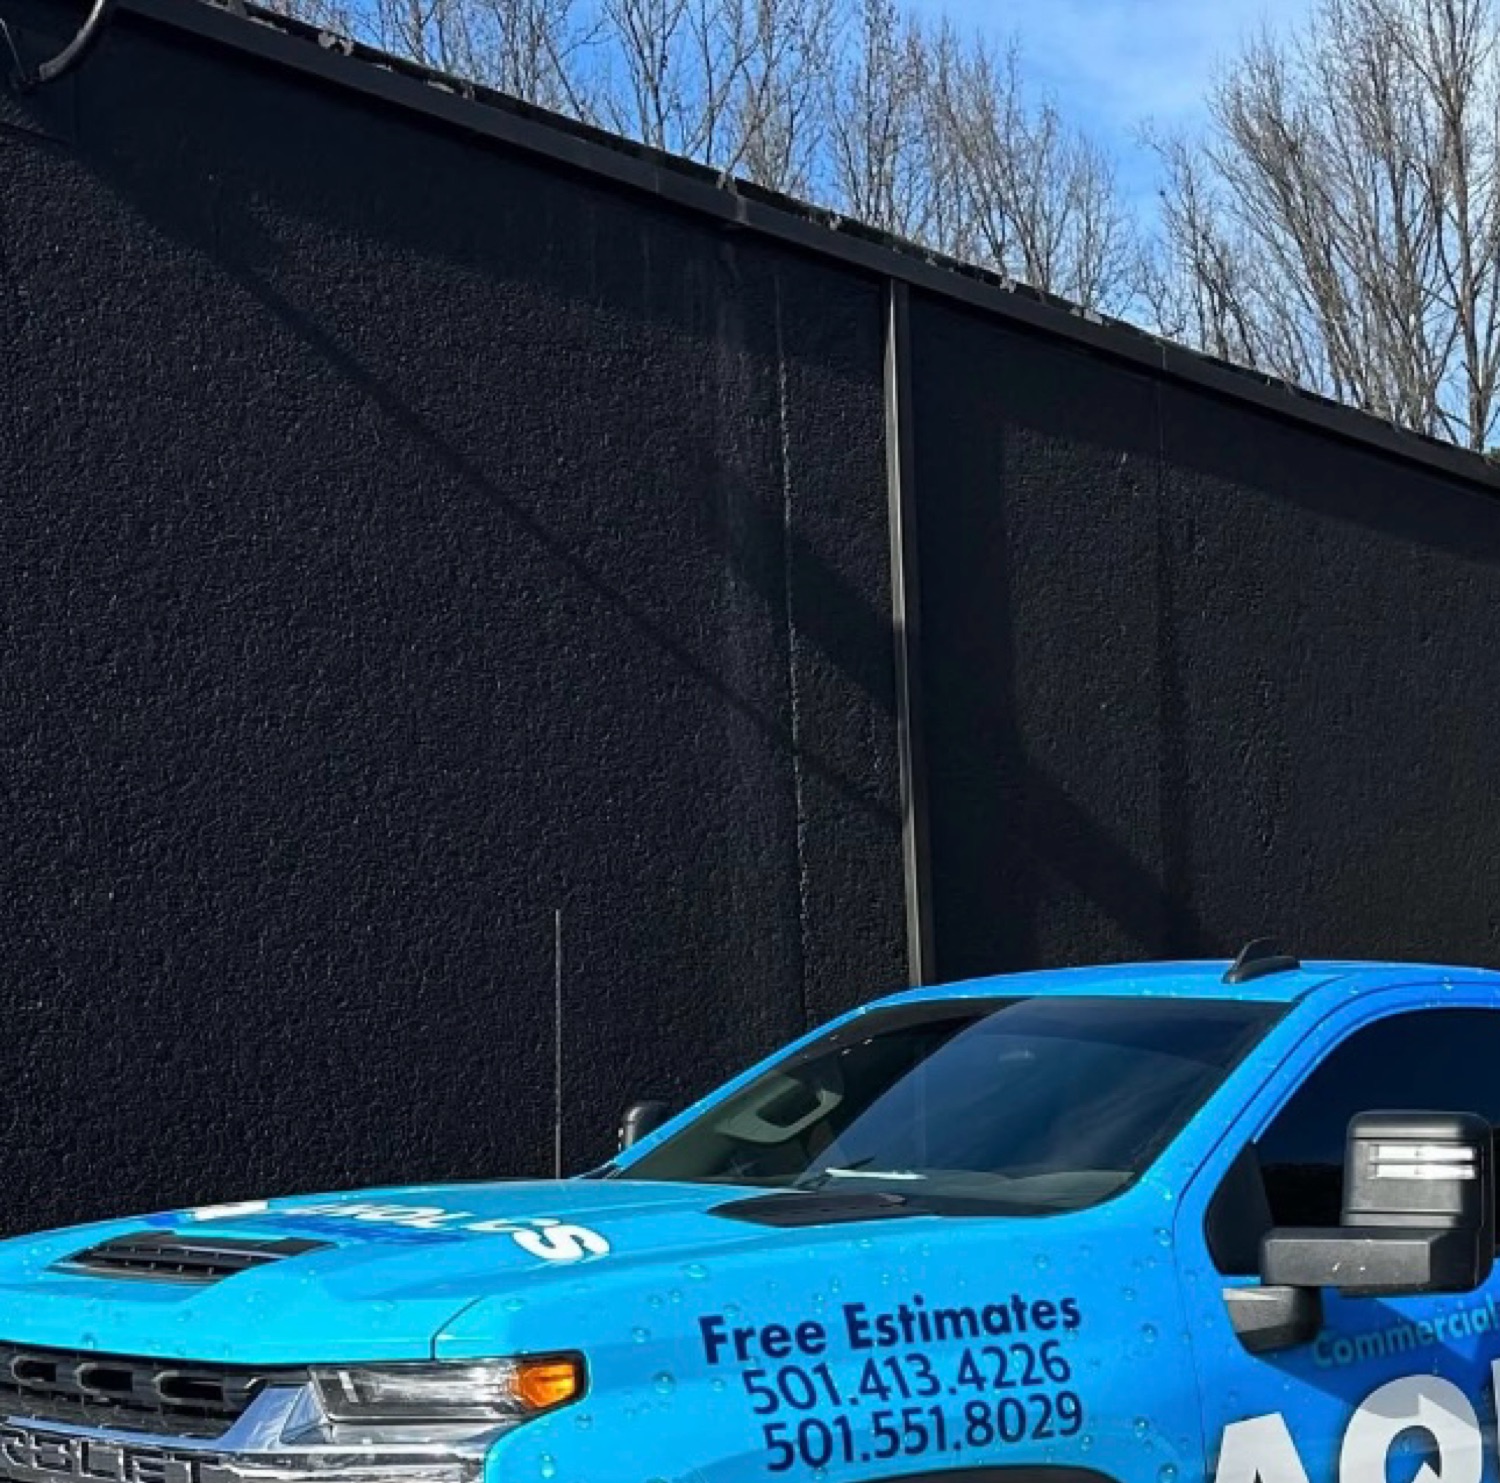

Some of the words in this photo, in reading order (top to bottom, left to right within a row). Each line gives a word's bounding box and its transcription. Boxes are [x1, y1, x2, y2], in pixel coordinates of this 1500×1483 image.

[698, 1314, 827, 1365] Free
[842, 1293, 1082, 1351] Estimates
[1314, 1303, 1499, 1367] Commercial
[742, 1339, 1071, 1415] 501.413.4226
[763, 1390, 1083, 1472] 501.551.8029
